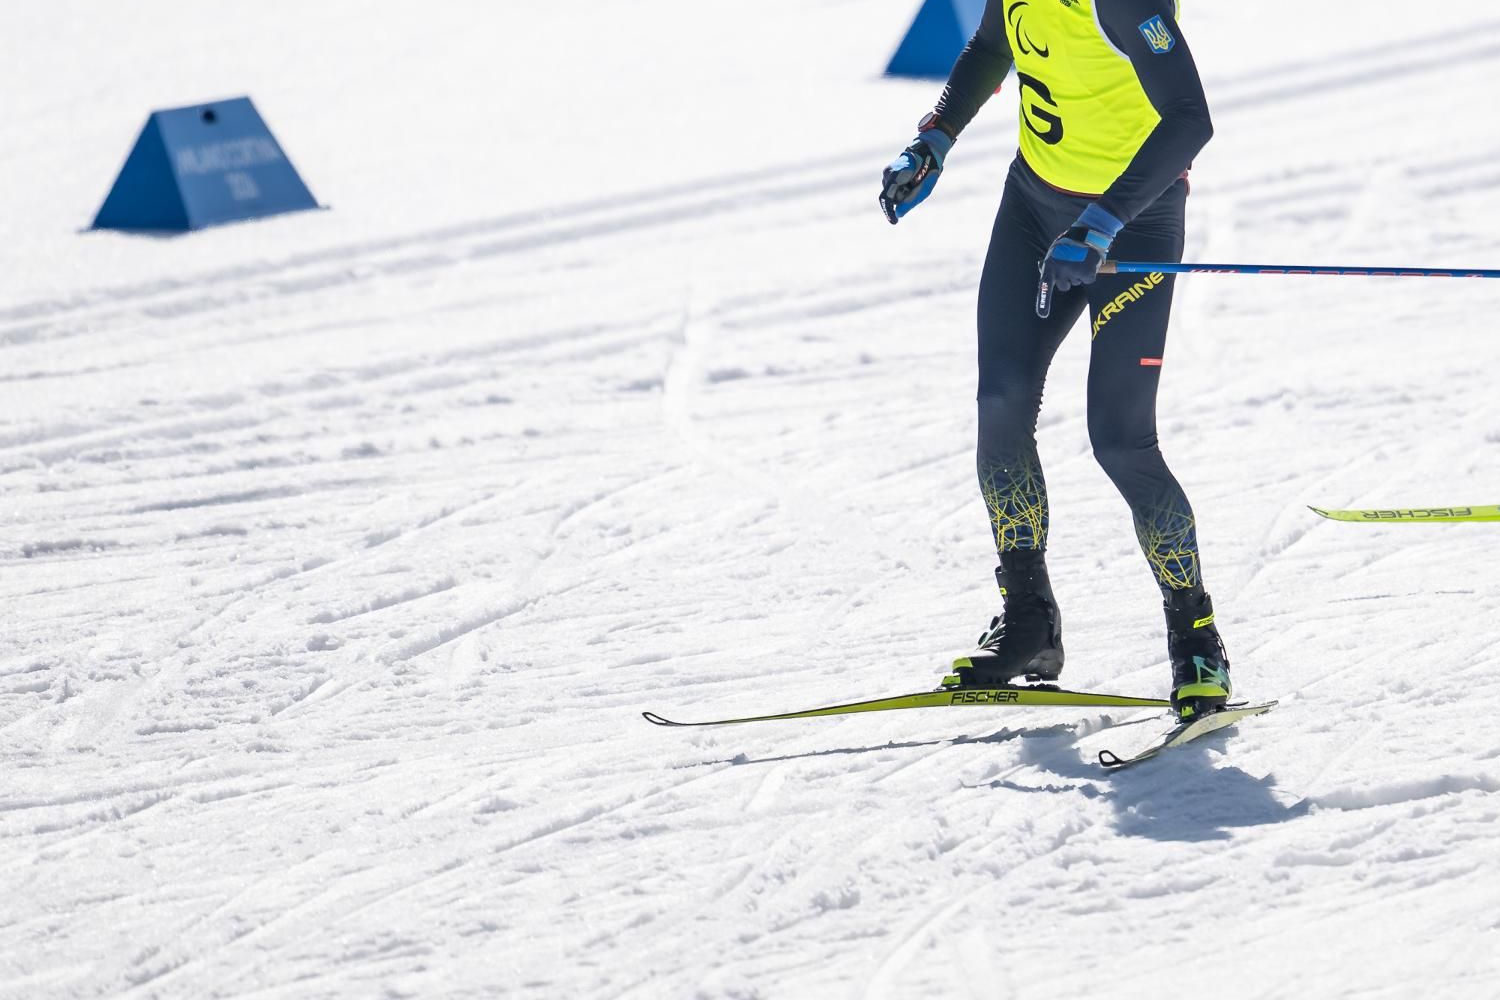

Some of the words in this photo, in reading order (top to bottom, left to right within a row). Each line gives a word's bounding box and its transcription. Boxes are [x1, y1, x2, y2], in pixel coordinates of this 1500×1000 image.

[1016, 71, 1064, 145] G
[1362, 506, 1472, 519] FISCHER
[951, 691, 1019, 704] FISCHER
